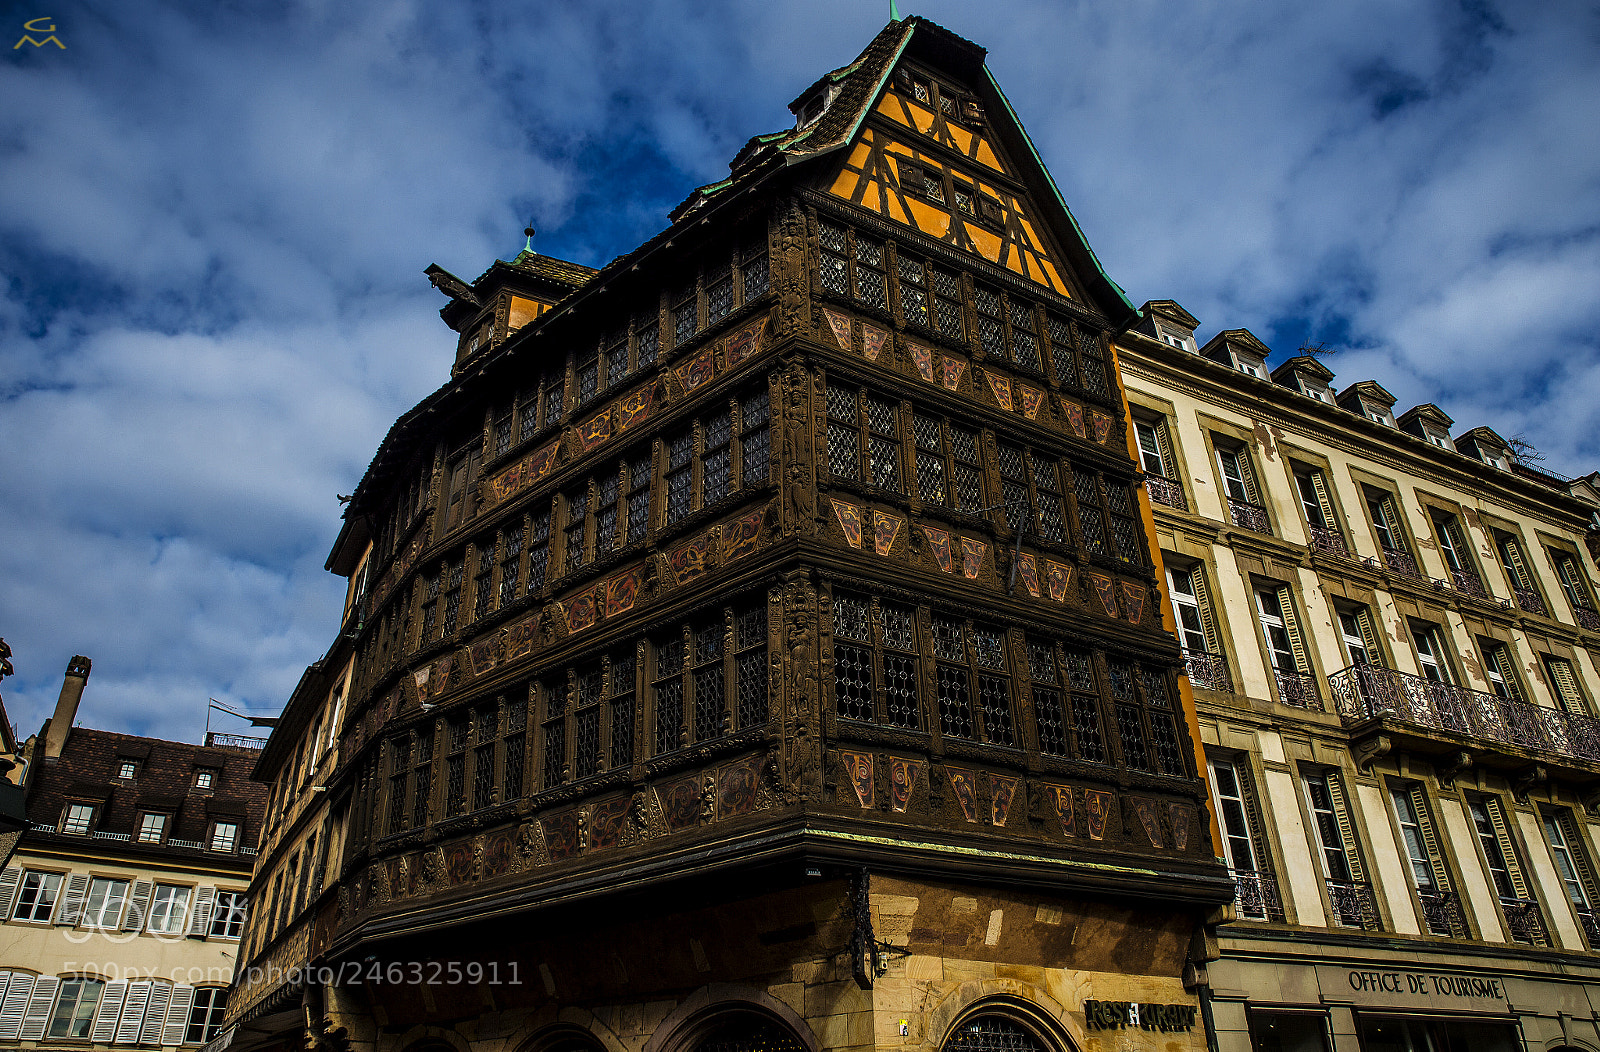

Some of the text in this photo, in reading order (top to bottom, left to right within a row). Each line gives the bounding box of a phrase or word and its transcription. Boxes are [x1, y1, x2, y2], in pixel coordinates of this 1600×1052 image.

[1349, 971, 1503, 999] OFFICE DE TOURISME
[1085, 999, 1197, 1028] RESTAURANT
